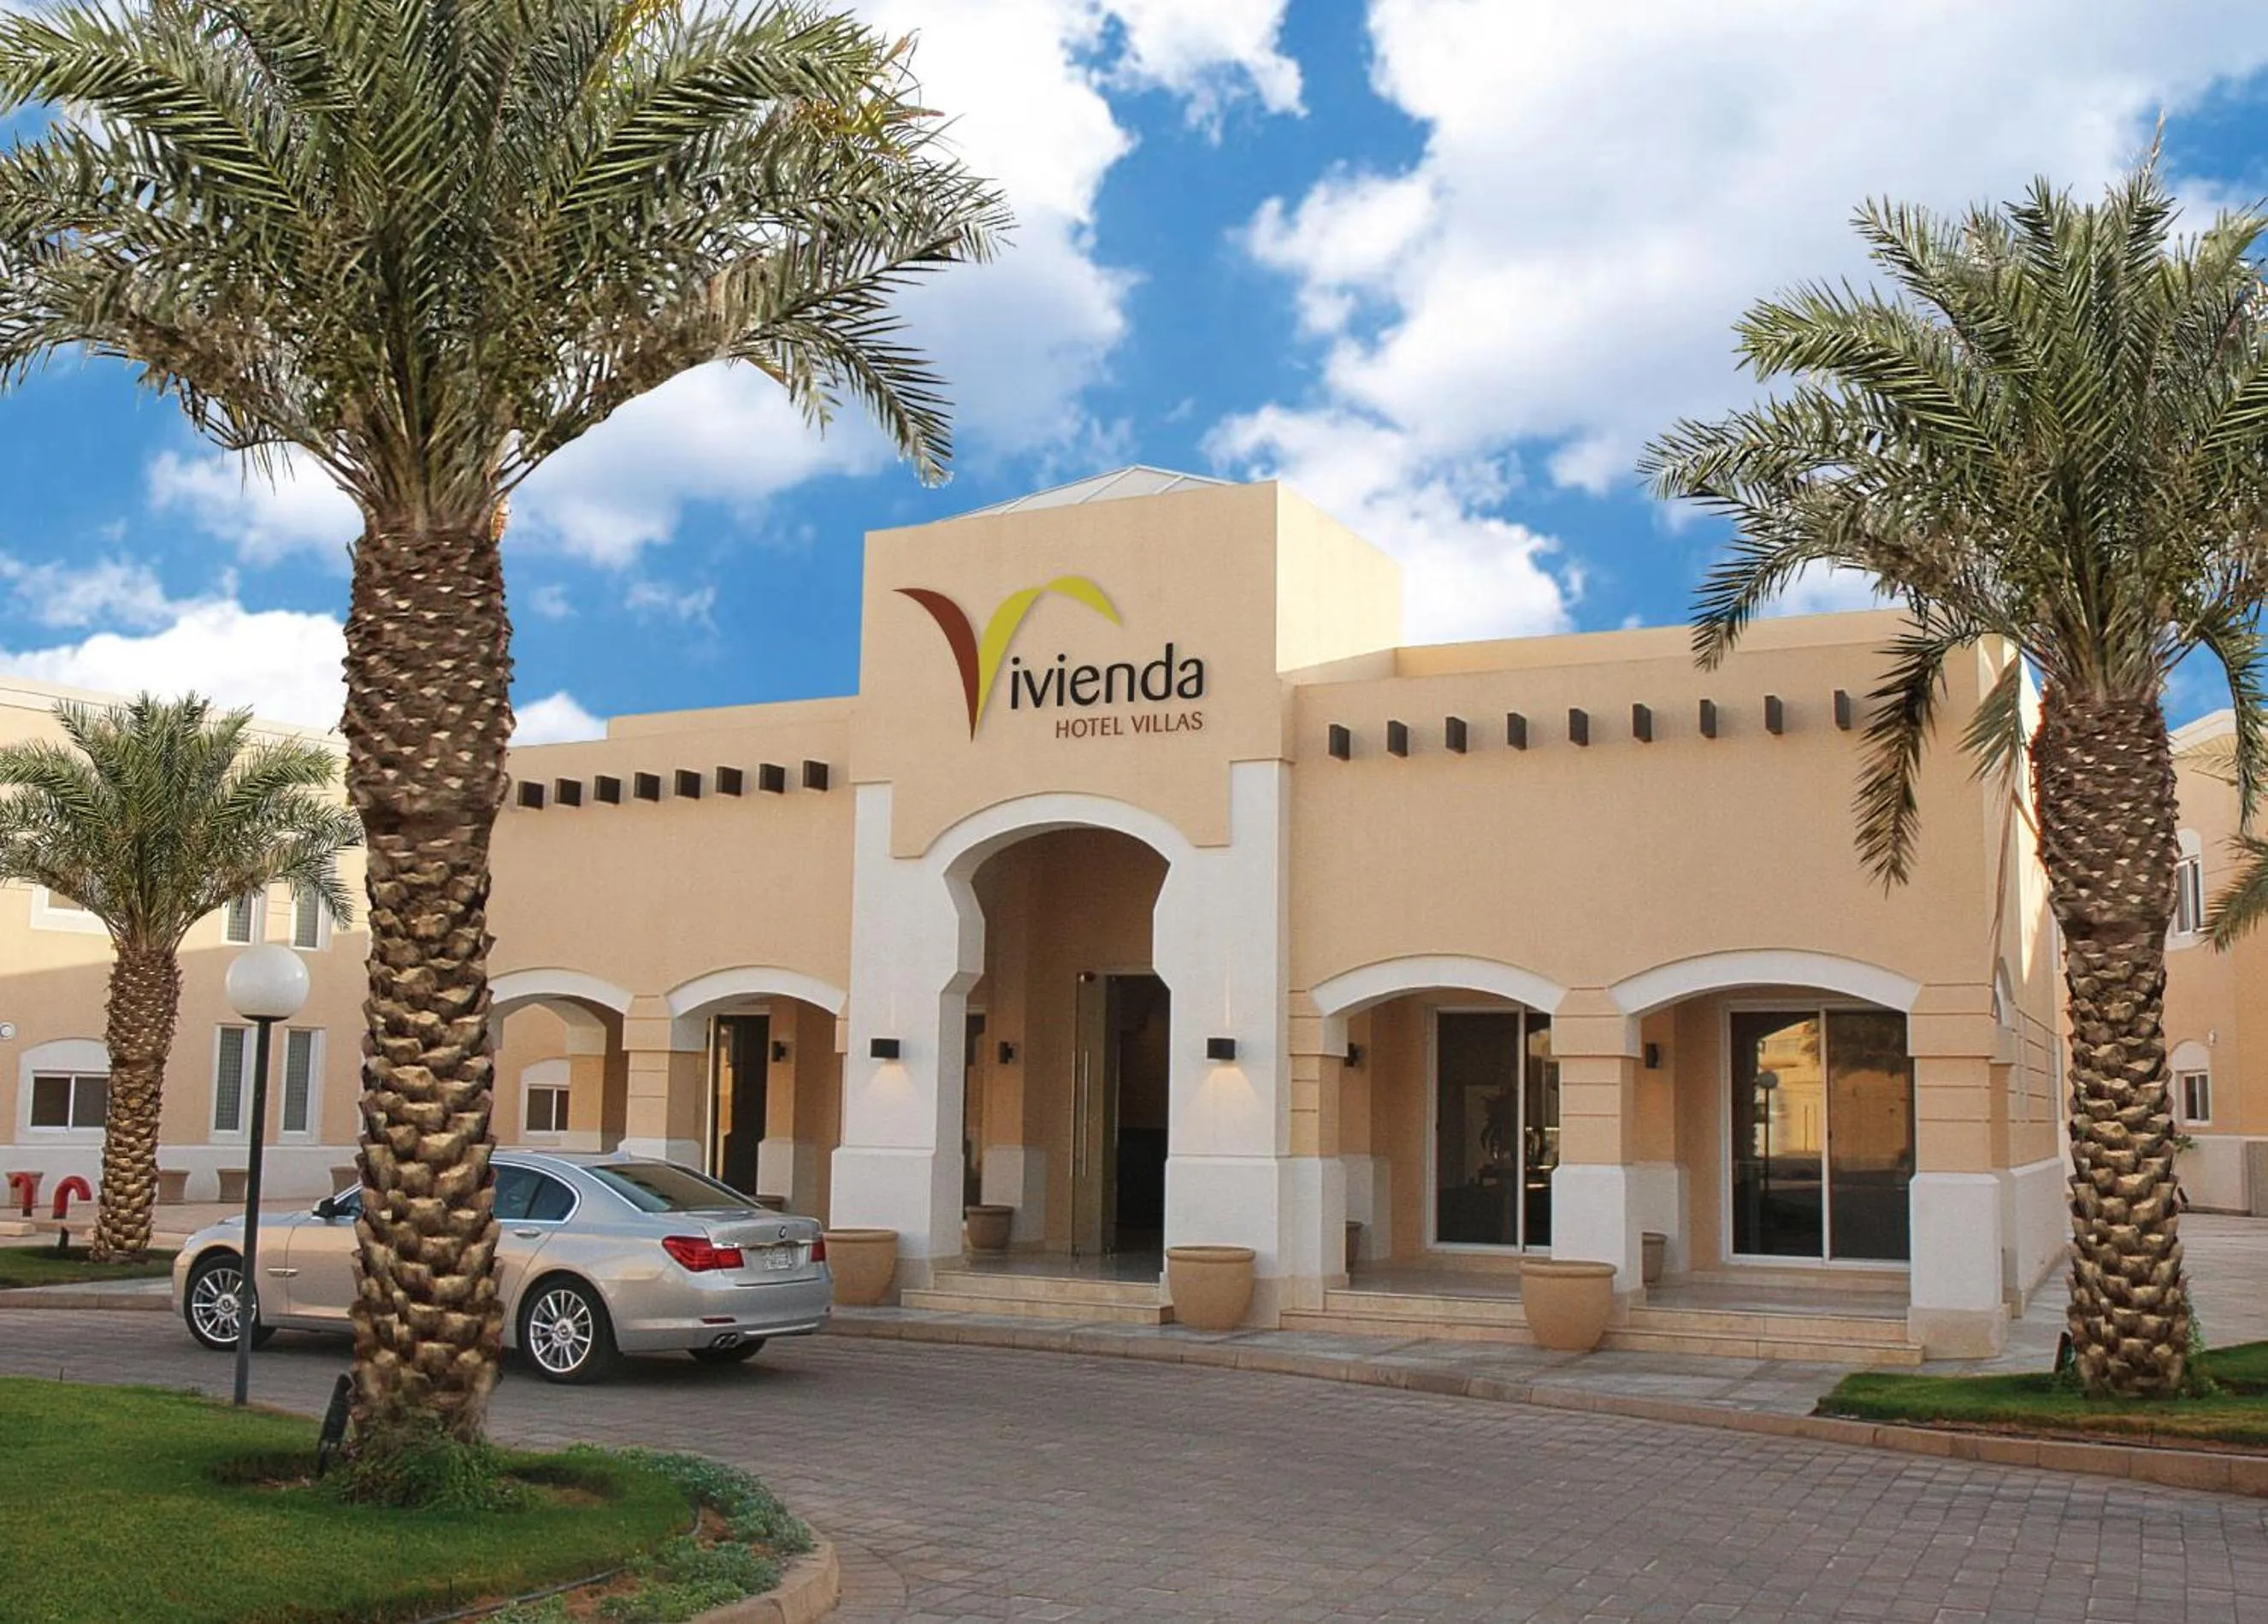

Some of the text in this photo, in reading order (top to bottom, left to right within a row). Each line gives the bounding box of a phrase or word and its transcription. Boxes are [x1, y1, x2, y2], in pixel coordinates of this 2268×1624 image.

[892, 576, 1204, 742] Vivienda
[1055, 712, 1204, 739] HOTEL VILLAS
